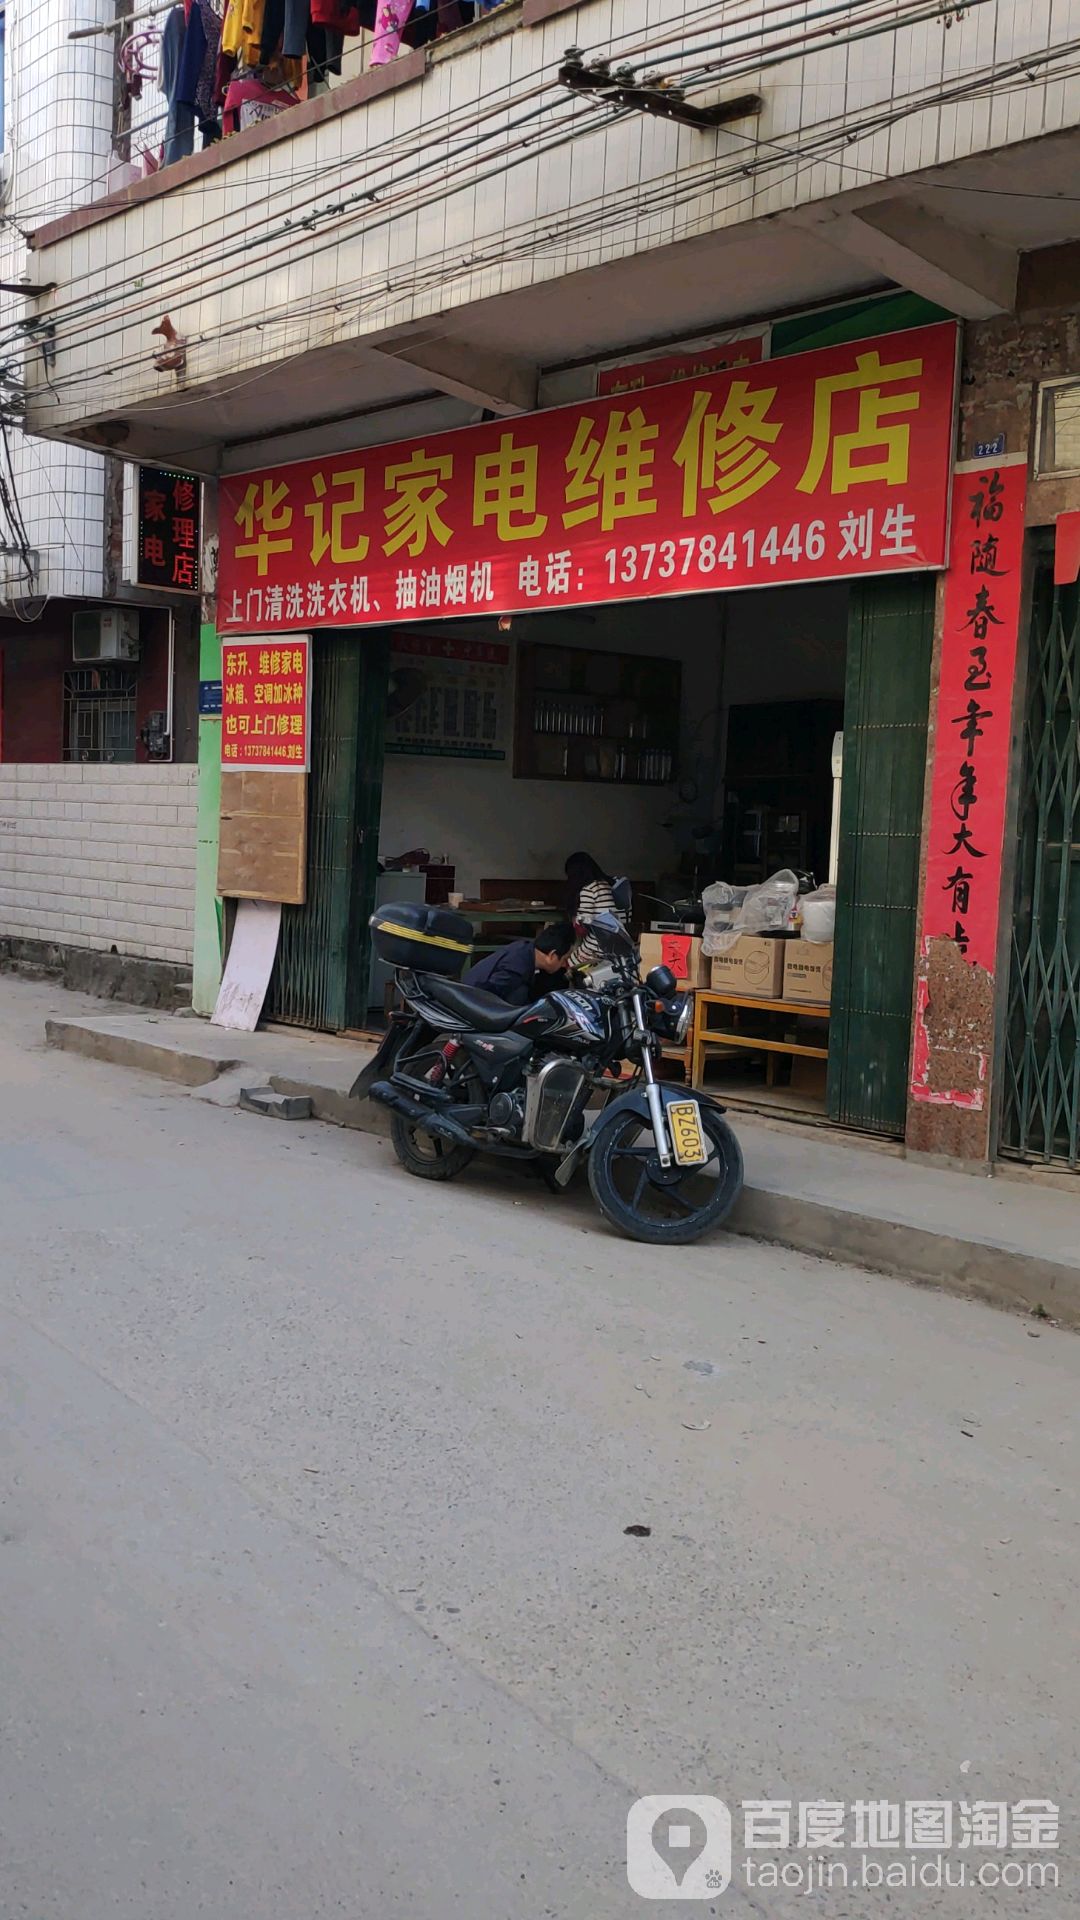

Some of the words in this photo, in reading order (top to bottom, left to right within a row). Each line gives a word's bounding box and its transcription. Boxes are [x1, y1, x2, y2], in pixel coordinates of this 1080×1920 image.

[234, 351, 923, 576] 华记家电维修店
[978, 442, 998, 455] 222
[144, 490, 166, 566] 家电
[172, 480, 194, 585] 修理店
[226, 561, 494, 623] 上门清洗洗衣机、抽油烟机
[604, 520, 825, 584] 13737841446
[837, 503, 916, 561] 刘生
[226, 714, 303, 736] 也可上门修理
[677, 1106, 701, 1158] BZ603
